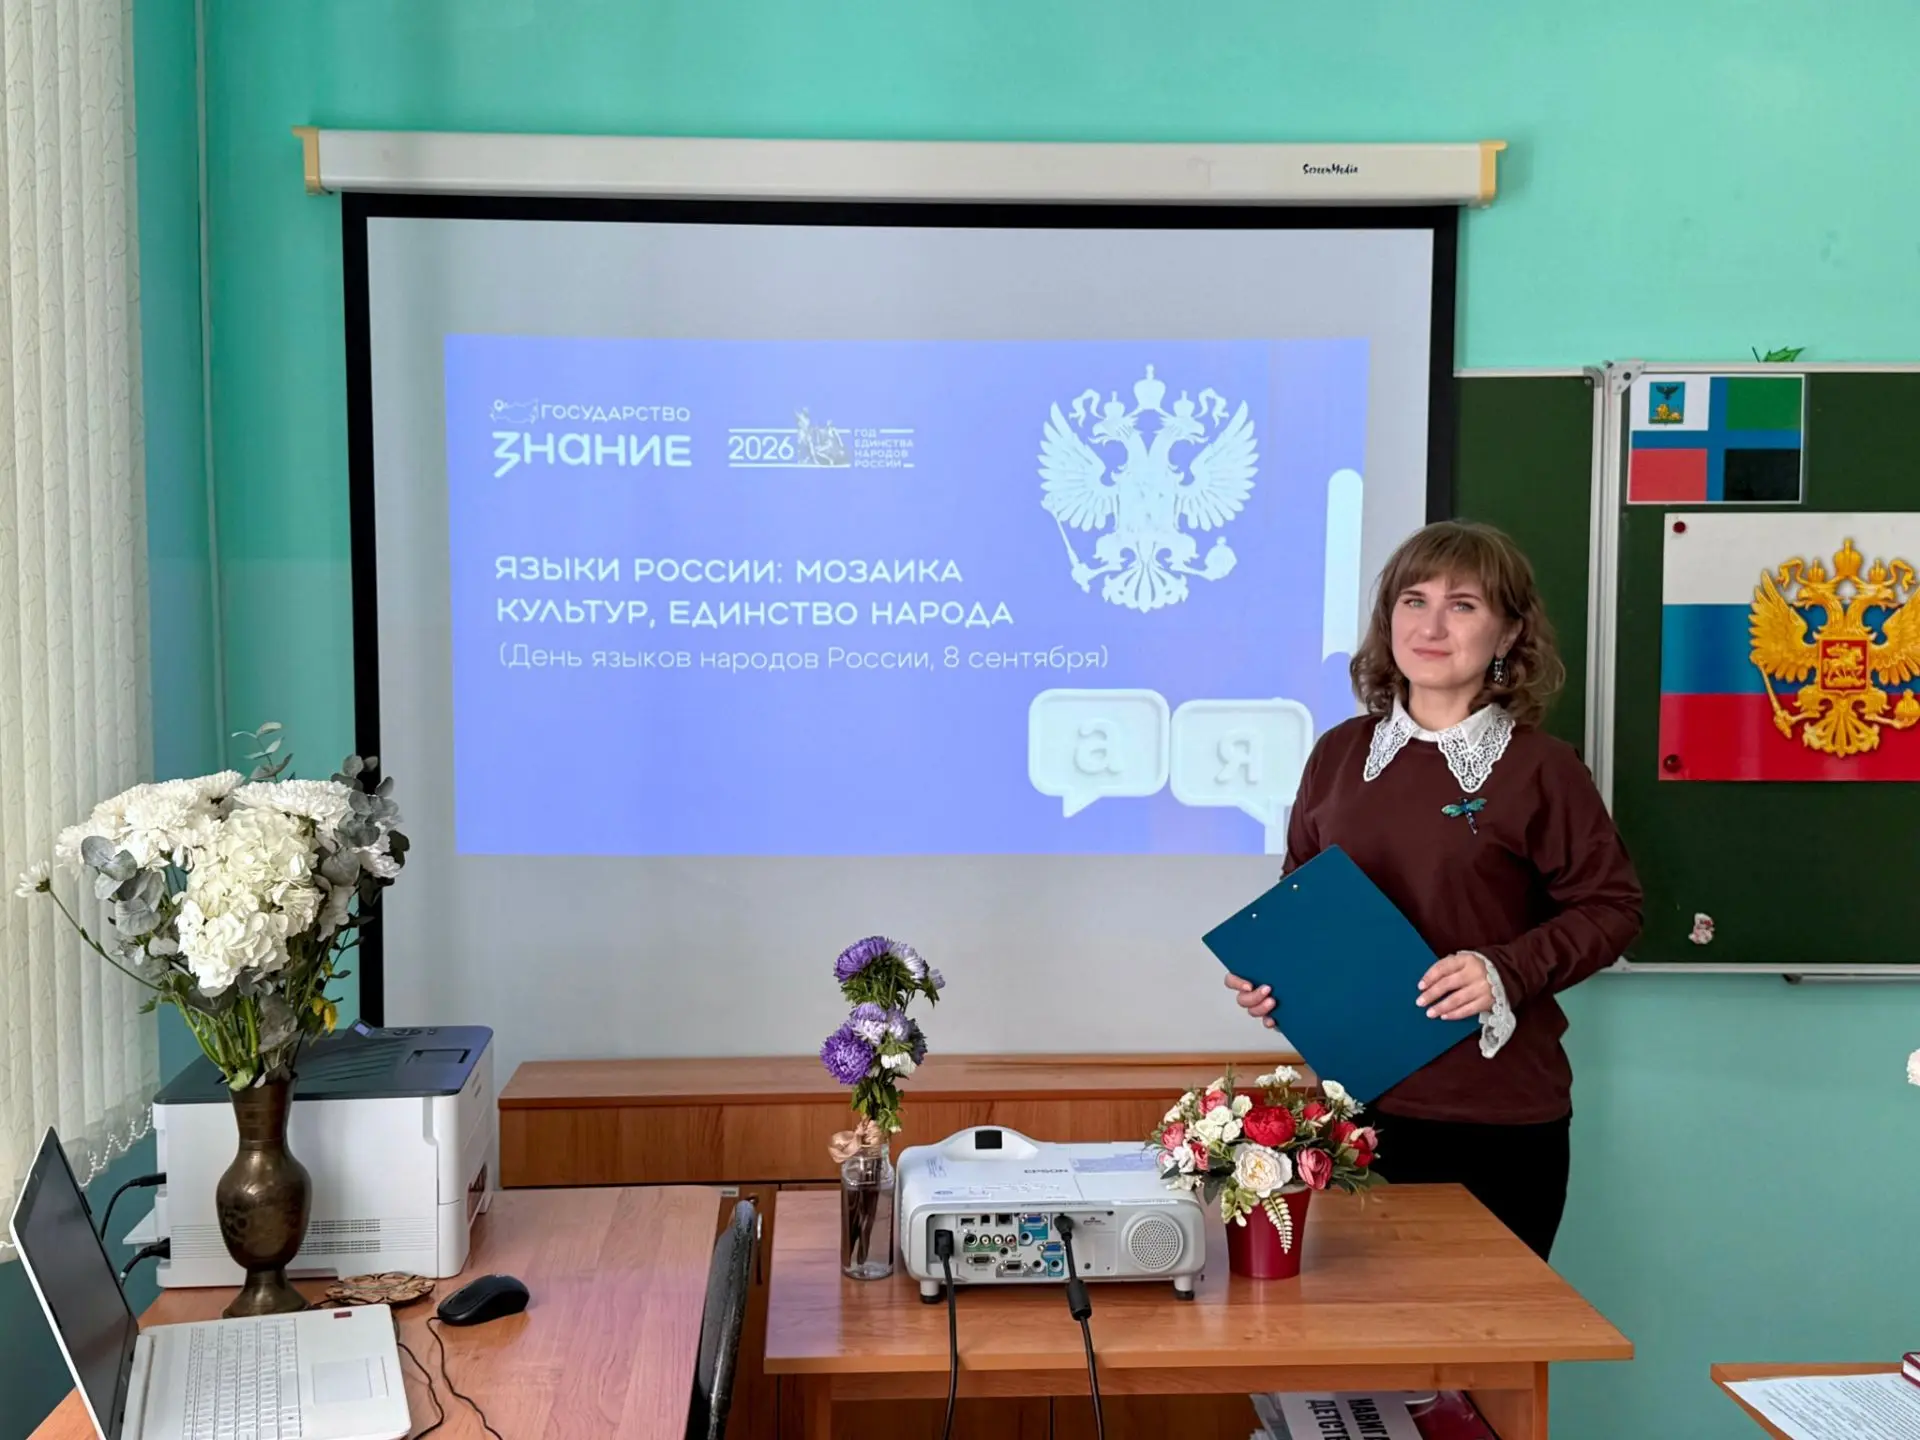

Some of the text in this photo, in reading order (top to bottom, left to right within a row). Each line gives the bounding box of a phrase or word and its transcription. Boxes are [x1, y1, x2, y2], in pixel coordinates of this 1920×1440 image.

[1302, 162, 1359, 175] ScreenMedia
[540, 403, 691, 423] ГОСУДАРСТВО
[854, 428, 877, 438] ГОД
[728, 435, 795, 461] 2026
[854, 439, 914, 449] ЕДИНСТВА
[854, 449, 909, 459] НАРОДОВ
[854, 459, 902, 469] РОССИИ
[494, 555, 964, 584] ЯЗЫКИ РОССИИ: МОЗАИКА
[496, 597, 1014, 629] КУЛЬТУР, ЕДИНСТВО НАРОДА
[500, 642, 1109, 674] (День языков народов России, 8 сентября)
